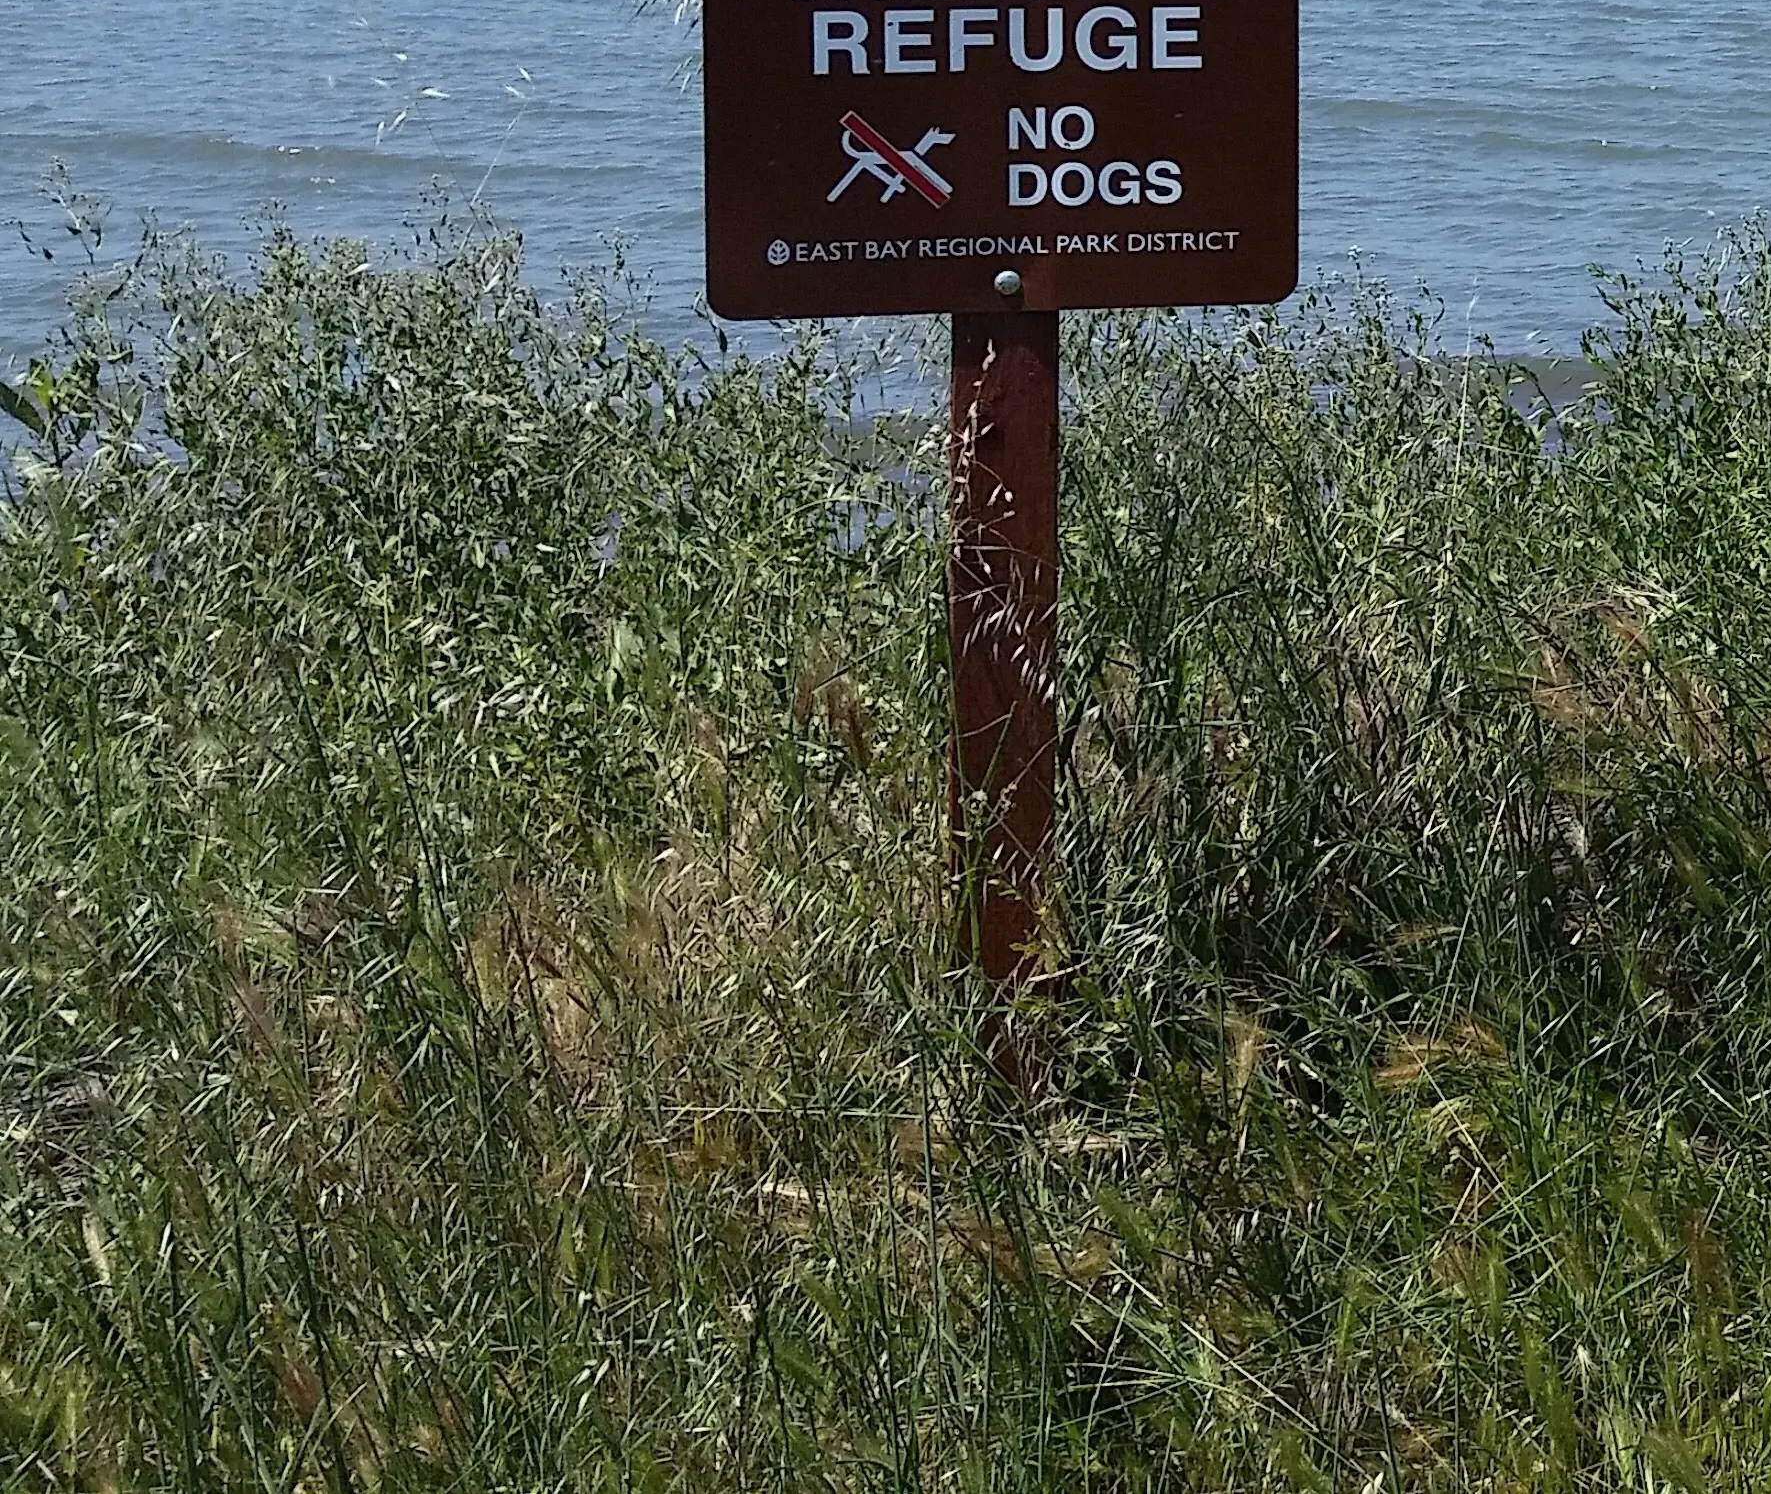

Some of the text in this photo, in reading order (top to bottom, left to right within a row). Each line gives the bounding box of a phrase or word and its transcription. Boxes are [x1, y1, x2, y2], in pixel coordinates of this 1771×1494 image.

[812, 6, 1203, 76] REFUGE
[1008, 105, 1095, 151] NO
[1008, 160, 1183, 207] DOGS
[796, 231, 1240, 261] EAST BAY REGIONAL PARK DISTRICT
